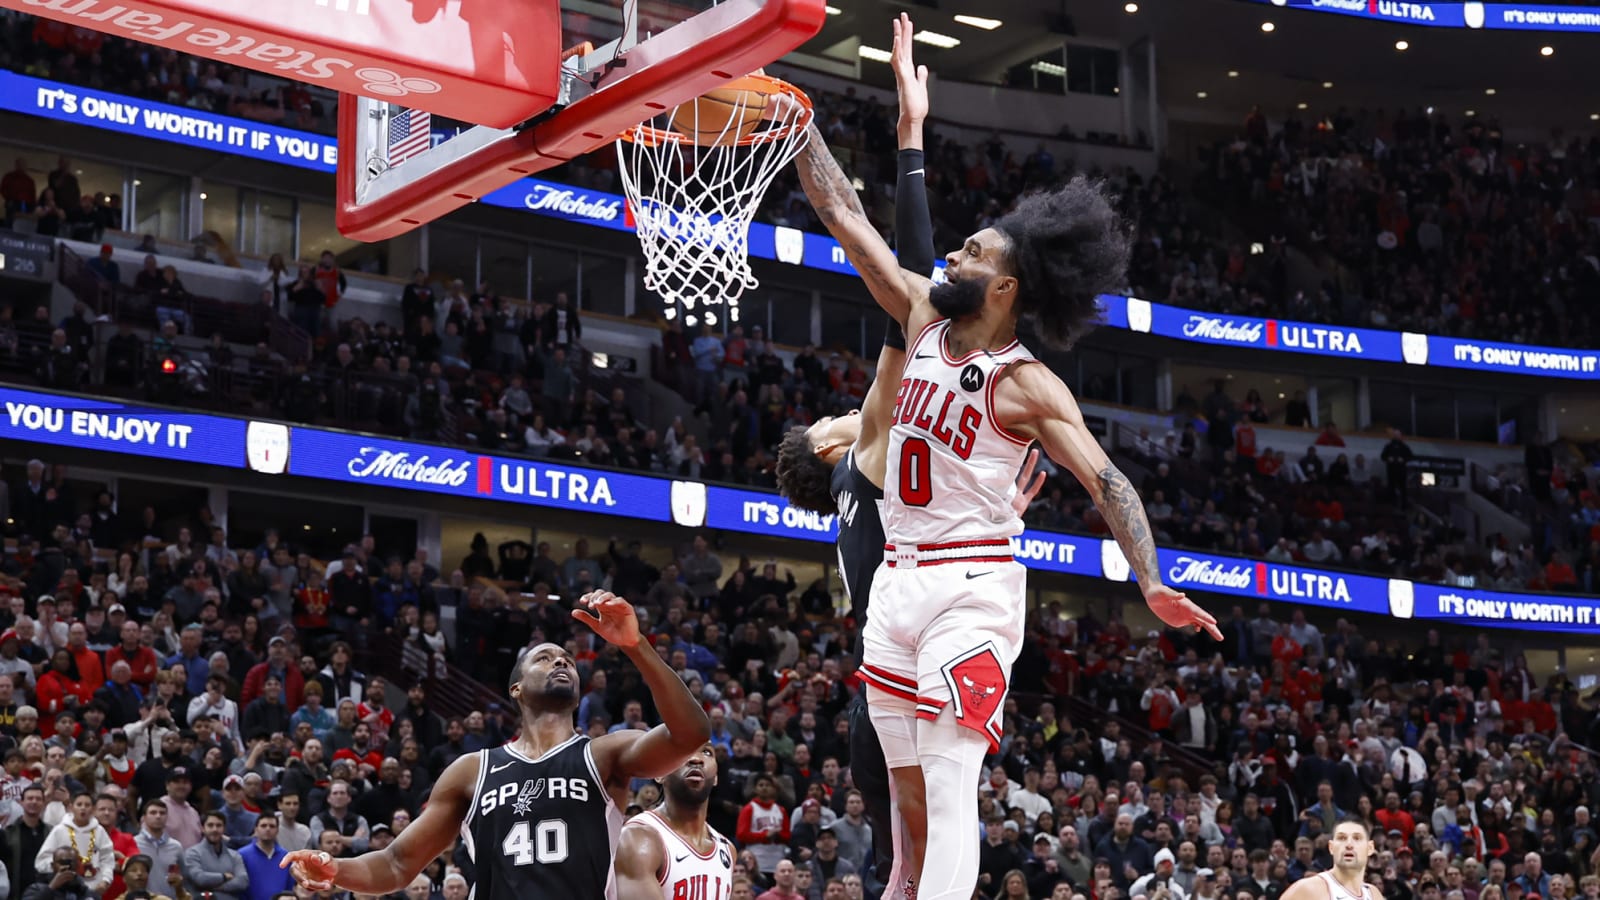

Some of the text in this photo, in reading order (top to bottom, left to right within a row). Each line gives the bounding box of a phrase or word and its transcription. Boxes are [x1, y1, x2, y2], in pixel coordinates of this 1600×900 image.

[1378, 1, 1435, 21] ULTRA
[1503, 9, 1600, 26] IT'S ONLY WORTH
[37, 87, 78, 114] IT'S
[81, 97, 140, 125] ONLY
[143, 109, 224, 142] WORTH
[228, 126, 248, 146] IT
[251, 130, 271, 151] IF
[275, 135, 319, 161] YOU
[524, 184, 620, 221] Michelob
[1183, 316, 1362, 353] Michelob ULTRA
[1454, 344, 1597, 372] IT'S ONLY WORTH IT
[5, 401, 193, 449] YOU ENJOY IT
[891, 378, 983, 461] BULLS
[347, 447, 616, 506] Michelob ULTRA
[899, 437, 933, 507] 0
[743, 501, 780, 526] IT'S
[782, 506, 834, 532] ONLY
[1009, 537, 1076, 564] NJOY IT
[1169, 556, 1351, 603] Michelob ULTRA
[1438, 594, 1465, 615] IT'S
[1466, 598, 1508, 619] ONLY
[1509, 602, 1574, 623] WORTH
[1576, 606, 1592, 624] IT
[481, 777, 589, 816] SPURS
[502, 818, 568, 866] 40
